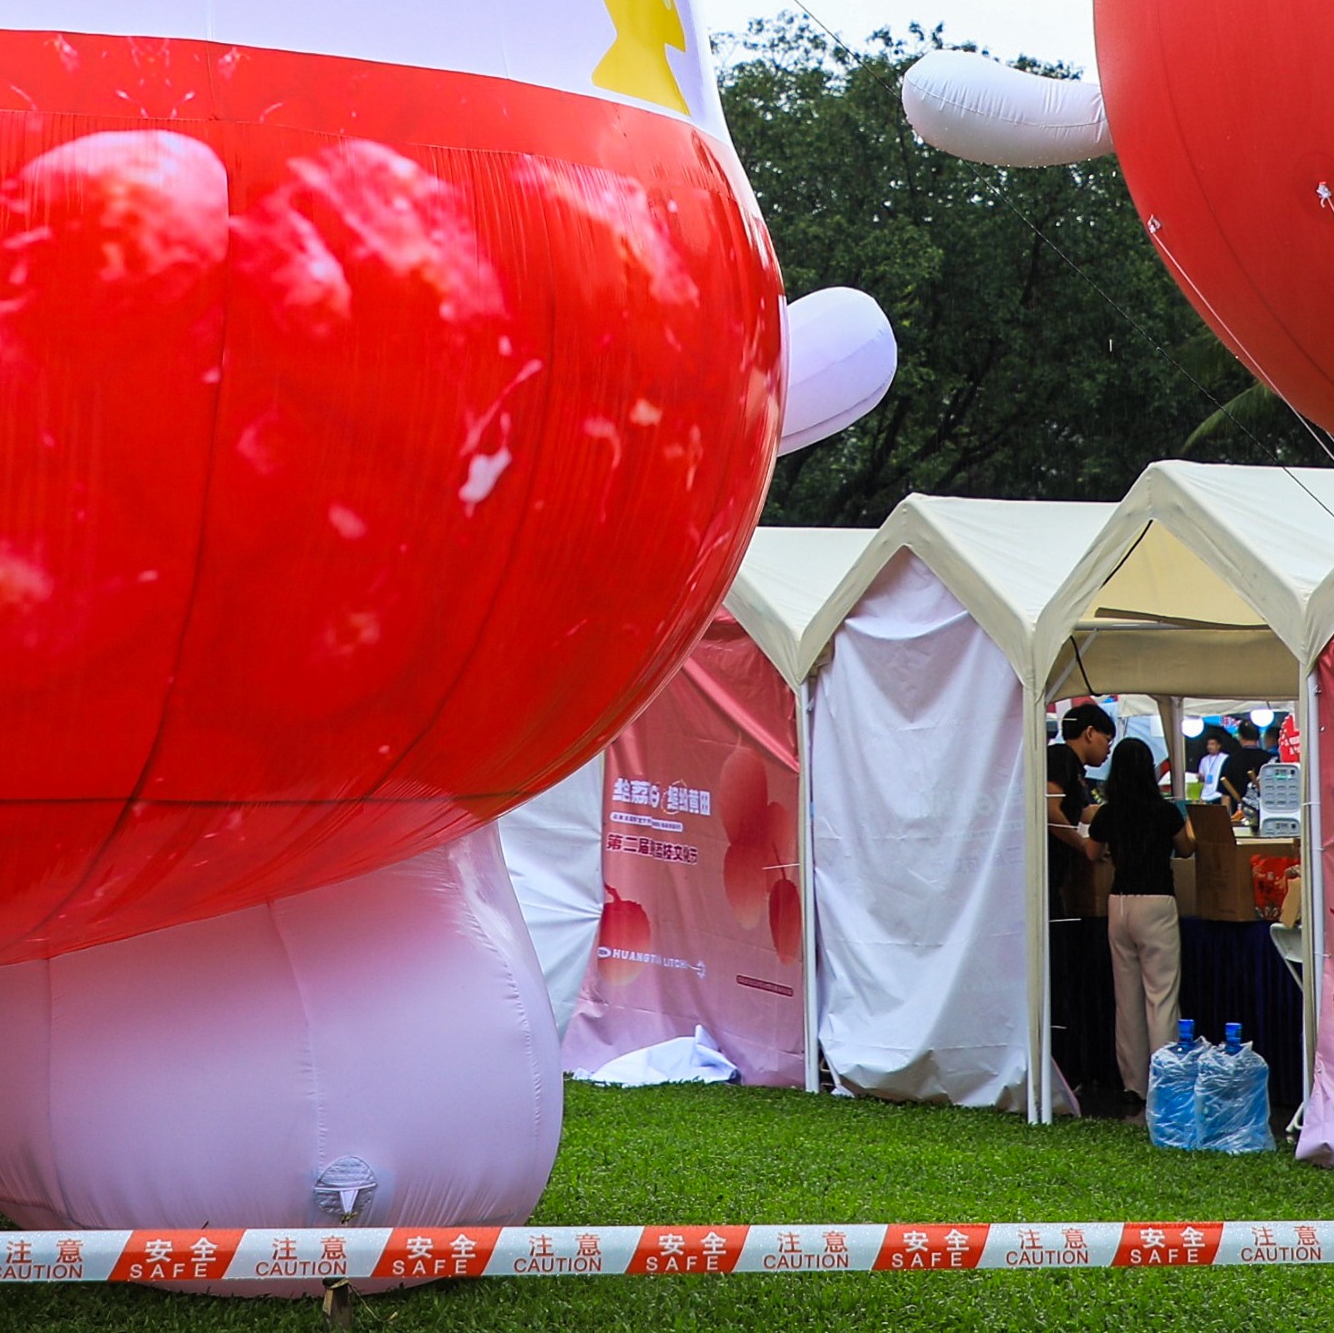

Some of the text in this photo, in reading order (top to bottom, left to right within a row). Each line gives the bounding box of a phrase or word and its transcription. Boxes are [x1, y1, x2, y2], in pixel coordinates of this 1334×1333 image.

[406, 1233, 478, 1259] 安全
[528, 1232, 602, 1257] 注意
[658, 1230, 727, 1256] 安全
[777, 1230, 848, 1254] 注意
[903, 1228, 970, 1252] 安全
[1019, 1228, 1087, 1250] 注意
[1139, 1226, 1206, 1248] 安全
[1251, 1225, 1321, 1247] 注意
[5, 1238, 83, 1264] 注意
[145, 1237, 218, 1264] 安全
[272, 1235, 347, 1261] 注意
[1005, 1249, 1089, 1266] CAUTION
[1129, 1248, 1199, 1264] SAFE
[1240, 1246, 1322, 1263] CAUTION
[129, 1262, 208, 1279] SAFE
[255, 1260, 347, 1276] CAUTION
[392, 1259, 468, 1275] SAFE
[513, 1256, 602, 1273] CAUTION
[645, 1256, 718, 1271] SAFE
[763, 1253, 849, 1269] CAUTION
[891, 1252, 963, 1268] SAFE
